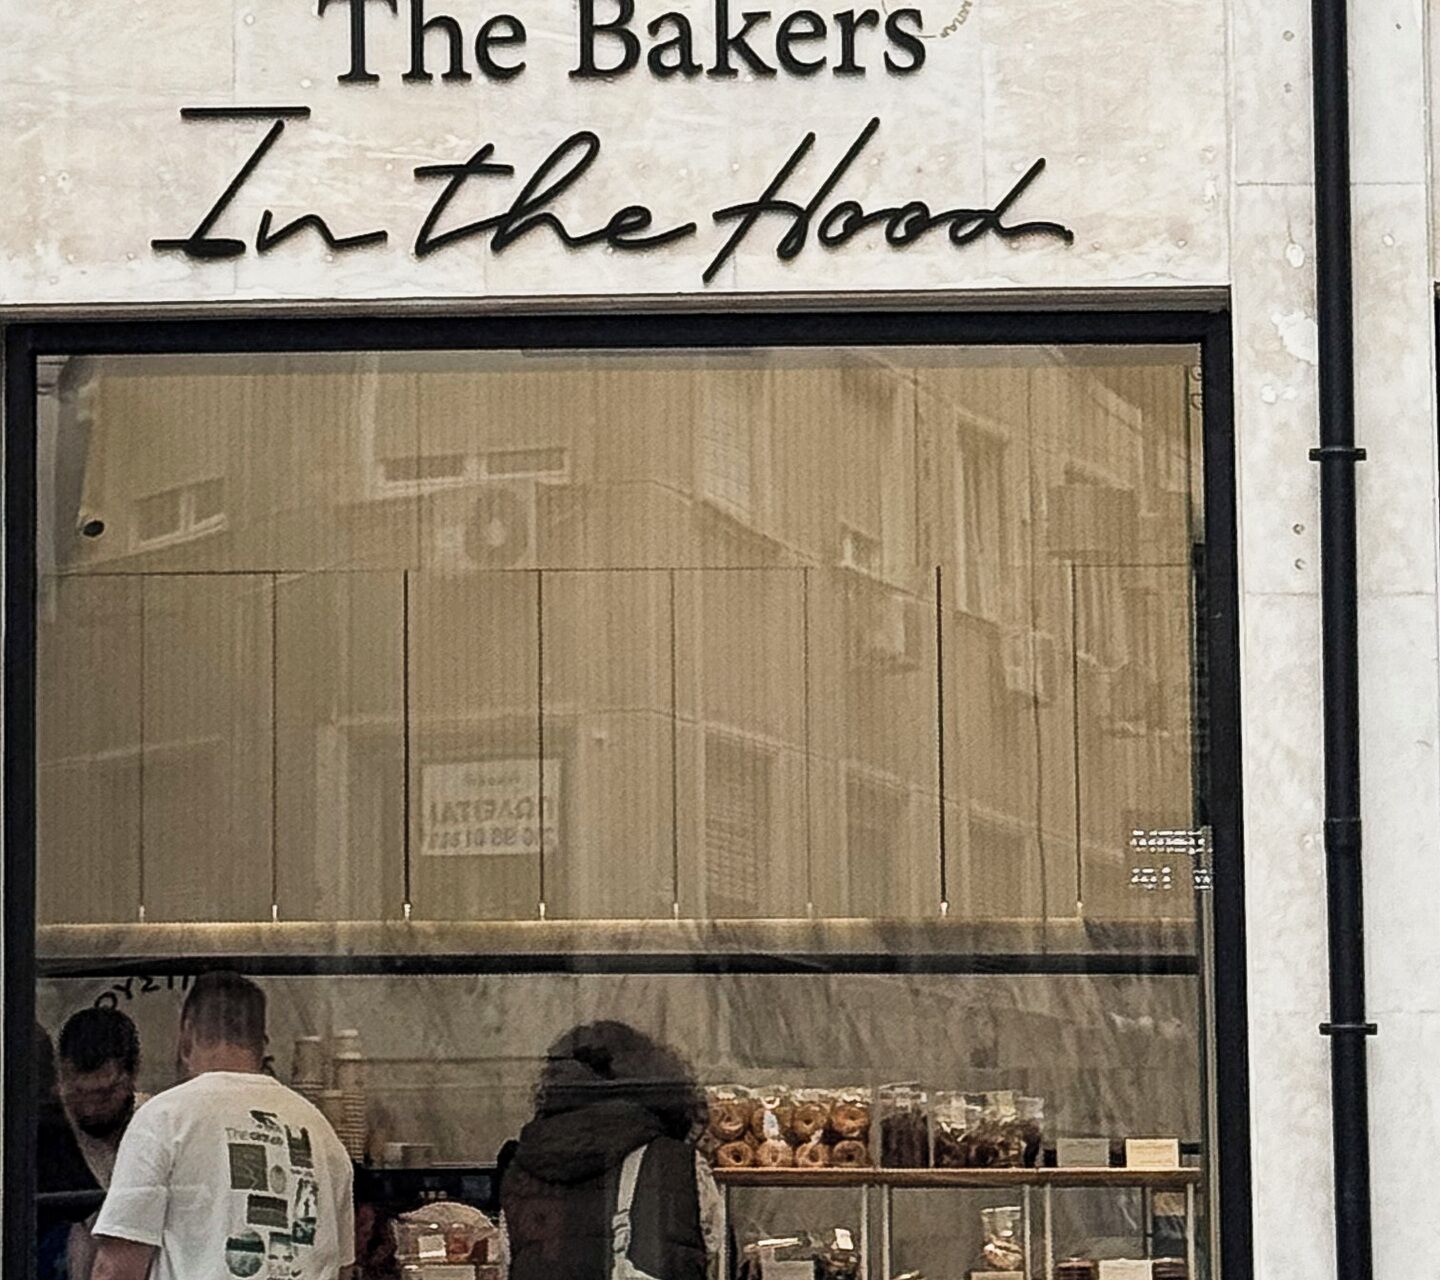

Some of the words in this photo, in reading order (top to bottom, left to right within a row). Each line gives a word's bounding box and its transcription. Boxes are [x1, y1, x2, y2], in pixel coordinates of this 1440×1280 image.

[151, 106, 388, 259] In
[413, 129, 697, 260] the
[702, 116, 1075, 284] Hood
